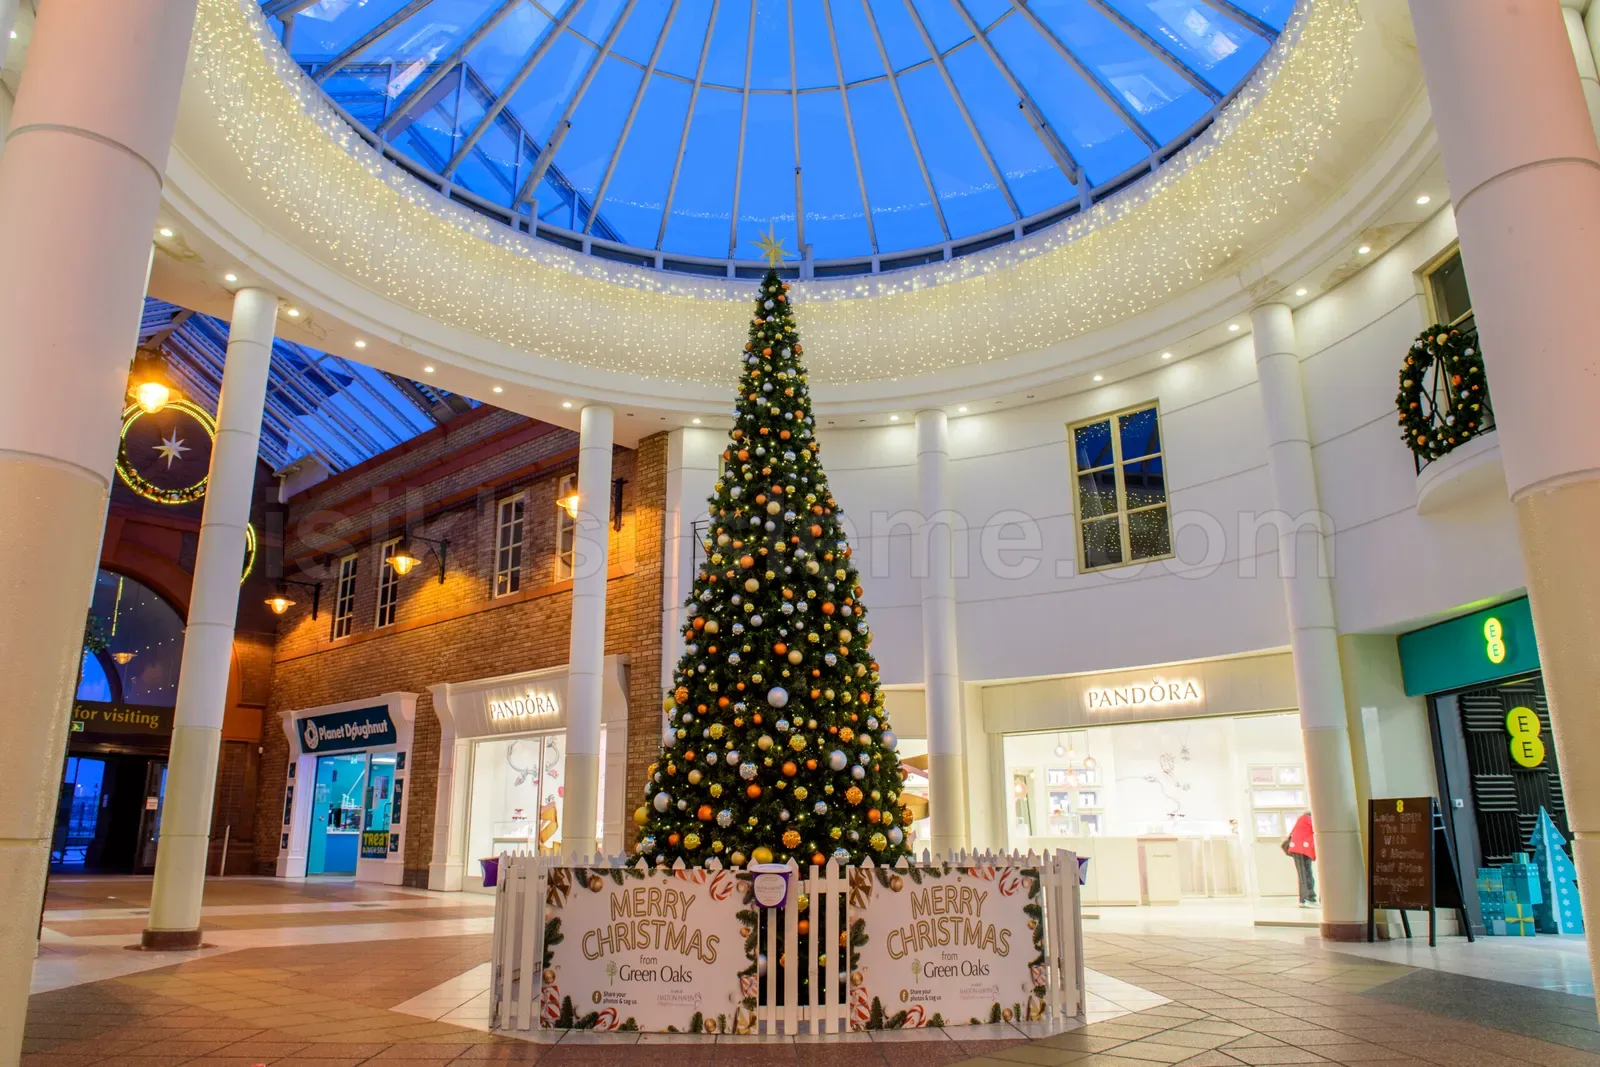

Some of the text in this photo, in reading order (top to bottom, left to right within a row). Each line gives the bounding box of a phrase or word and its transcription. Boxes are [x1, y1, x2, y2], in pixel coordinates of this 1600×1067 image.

[1087, 679, 1200, 708] PANDORA
[74, 705, 160, 729] for visiting
[488, 694, 556, 720] PANDORA
[318, 725, 345, 741] Planet
[610, 887, 696, 921] MERRY
[910, 885, 988, 920] MERRY
[582, 919, 720, 964] CHRISTMAS
[886, 916, 1012, 960] CHRISTMAS
[639, 954, 658, 965] from
[923, 959, 990, 978] Green Oaks
[941, 951, 958, 961] from
[619, 964, 693, 983] Green Oaks
